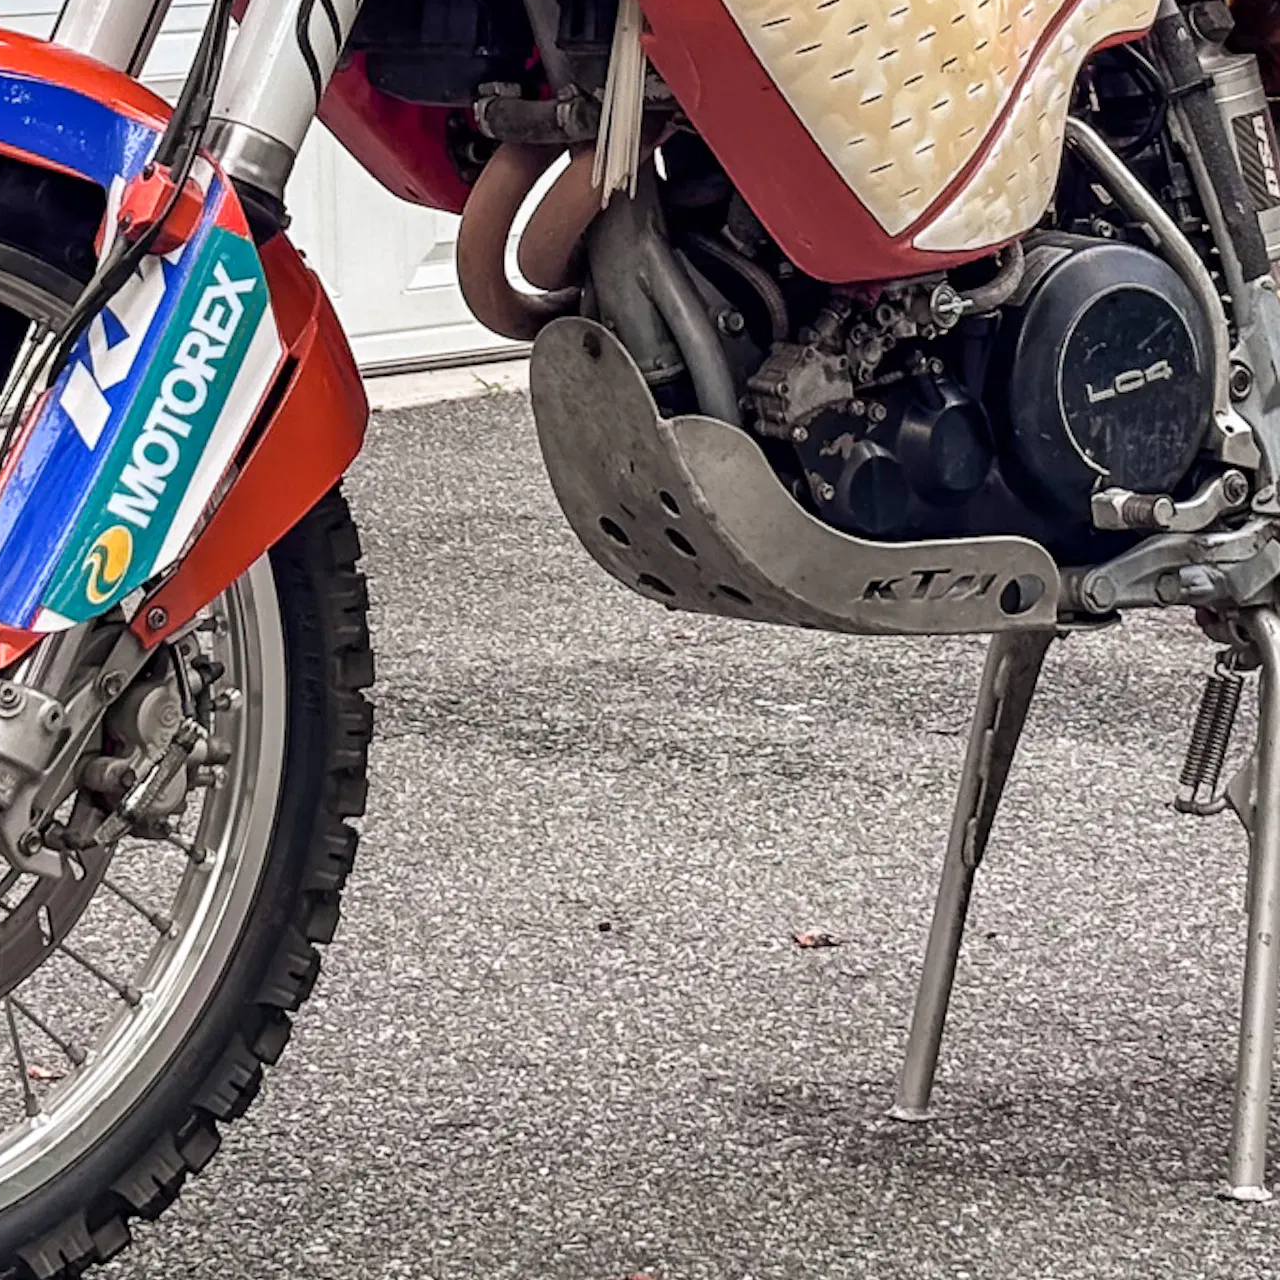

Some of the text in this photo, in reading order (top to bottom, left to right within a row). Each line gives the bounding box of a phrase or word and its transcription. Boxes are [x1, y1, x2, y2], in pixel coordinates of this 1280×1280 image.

[106, 261, 258, 530] MOTOREX
[1085, 360, 1173, 403] LC4
[861, 568, 997, 601] KTM
